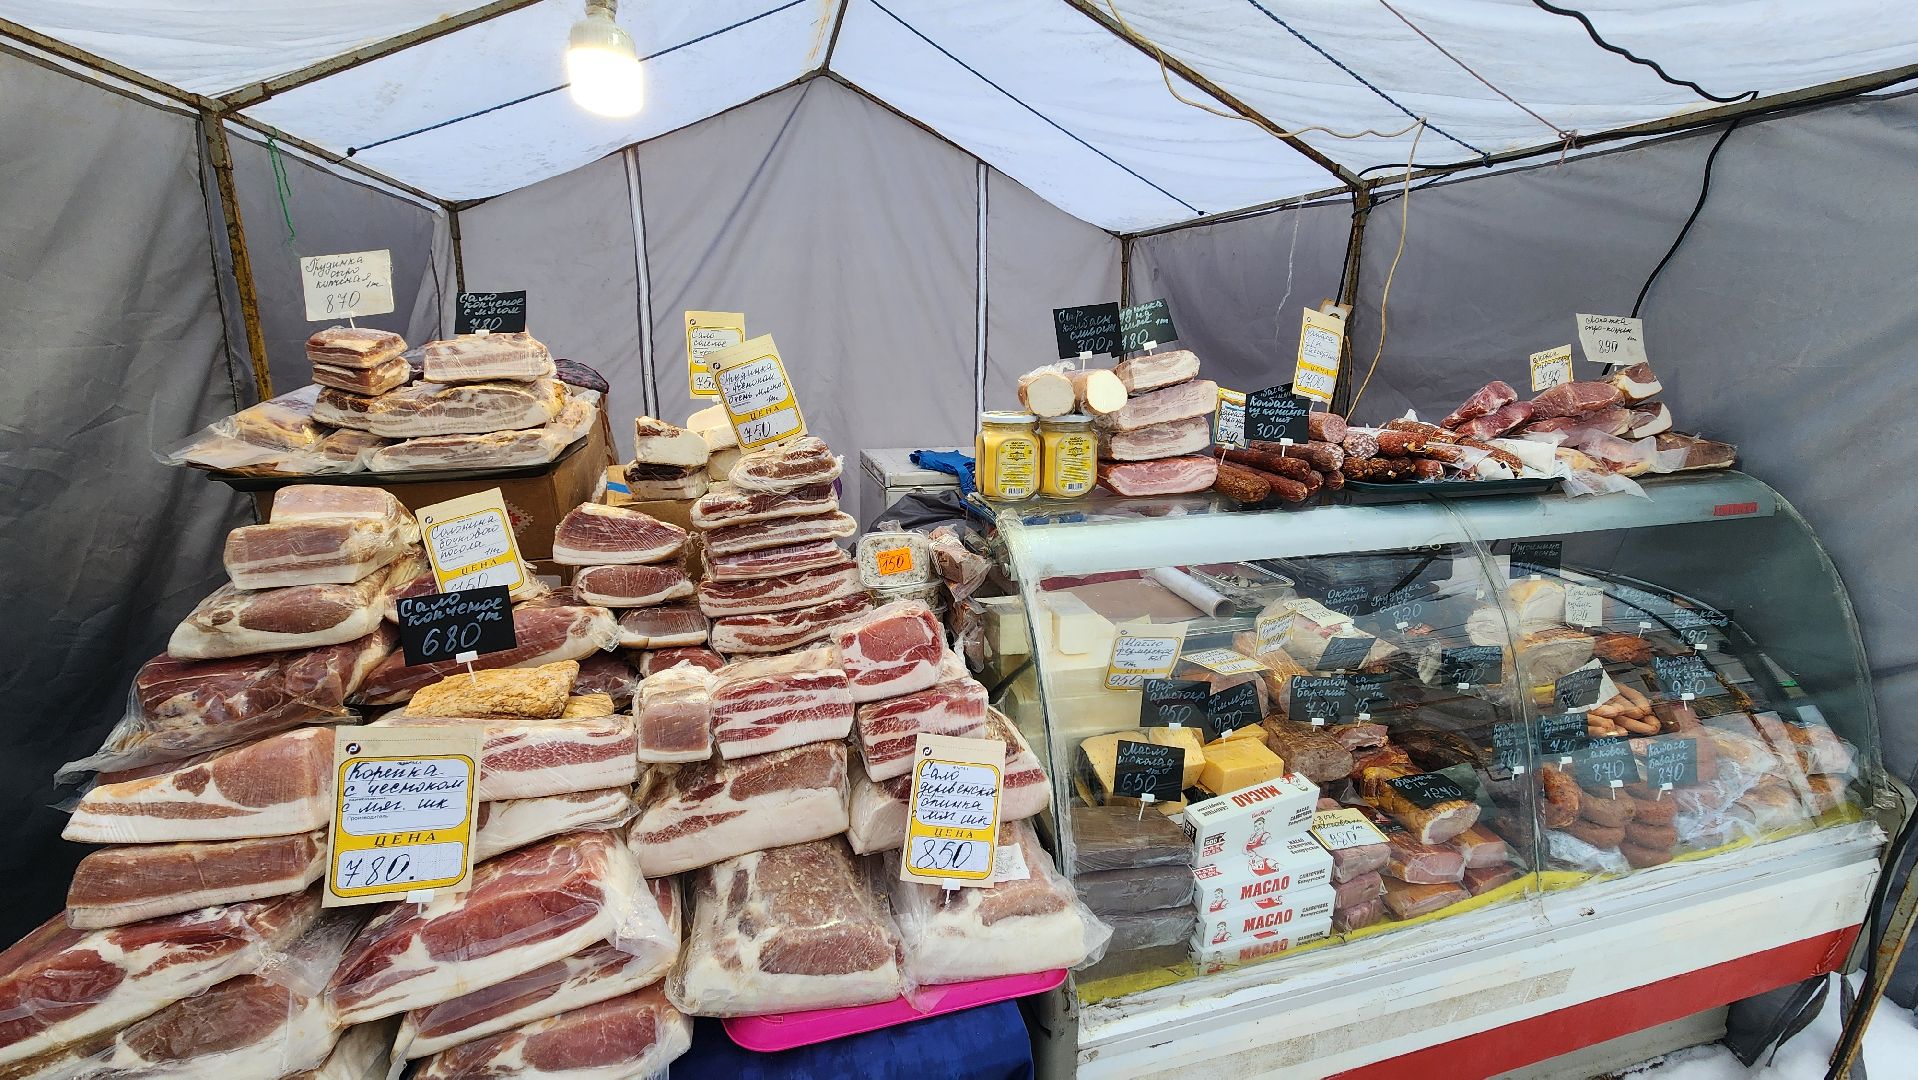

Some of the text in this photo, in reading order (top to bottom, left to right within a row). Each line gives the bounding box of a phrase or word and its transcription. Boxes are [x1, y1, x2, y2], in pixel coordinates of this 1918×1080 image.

[327, 291, 361, 314] 870
[460, 293, 497, 304] Сало
[749, 405, 780, 420] ЦЕНА
[1248, 407, 1261, 419] из
[1255, 424, 1286, 440] 300
[460, 558, 499, 575] ЦЕНА
[881, 555, 905, 572] 150
[400, 592, 461, 618] Сало
[1392, 603, 1423, 624] 820
[422, 621, 482, 657] 680
[1147, 679, 1174, 694] Сыр
[1214, 709, 1243, 736] 920
[1122, 742, 1169, 756] Масло
[920, 760, 960, 780] Сало
[343, 779, 465, 798] с чесноком
[1121, 773, 1157, 793] 650
[1231, 784, 1284, 808] МАСЛО
[341, 803, 350, 813] с
[373, 832, 437, 848] ЦЕНА
[933, 828, 974, 839] ЦЕНА
[916, 839, 973, 870] 850
[344, 853, 415, 887] 780.
[1240, 875, 1290, 900] МАСЛО
[1243, 908, 1293, 933] МАСЛО
[1239, 938, 1289, 961] МАСЛО
